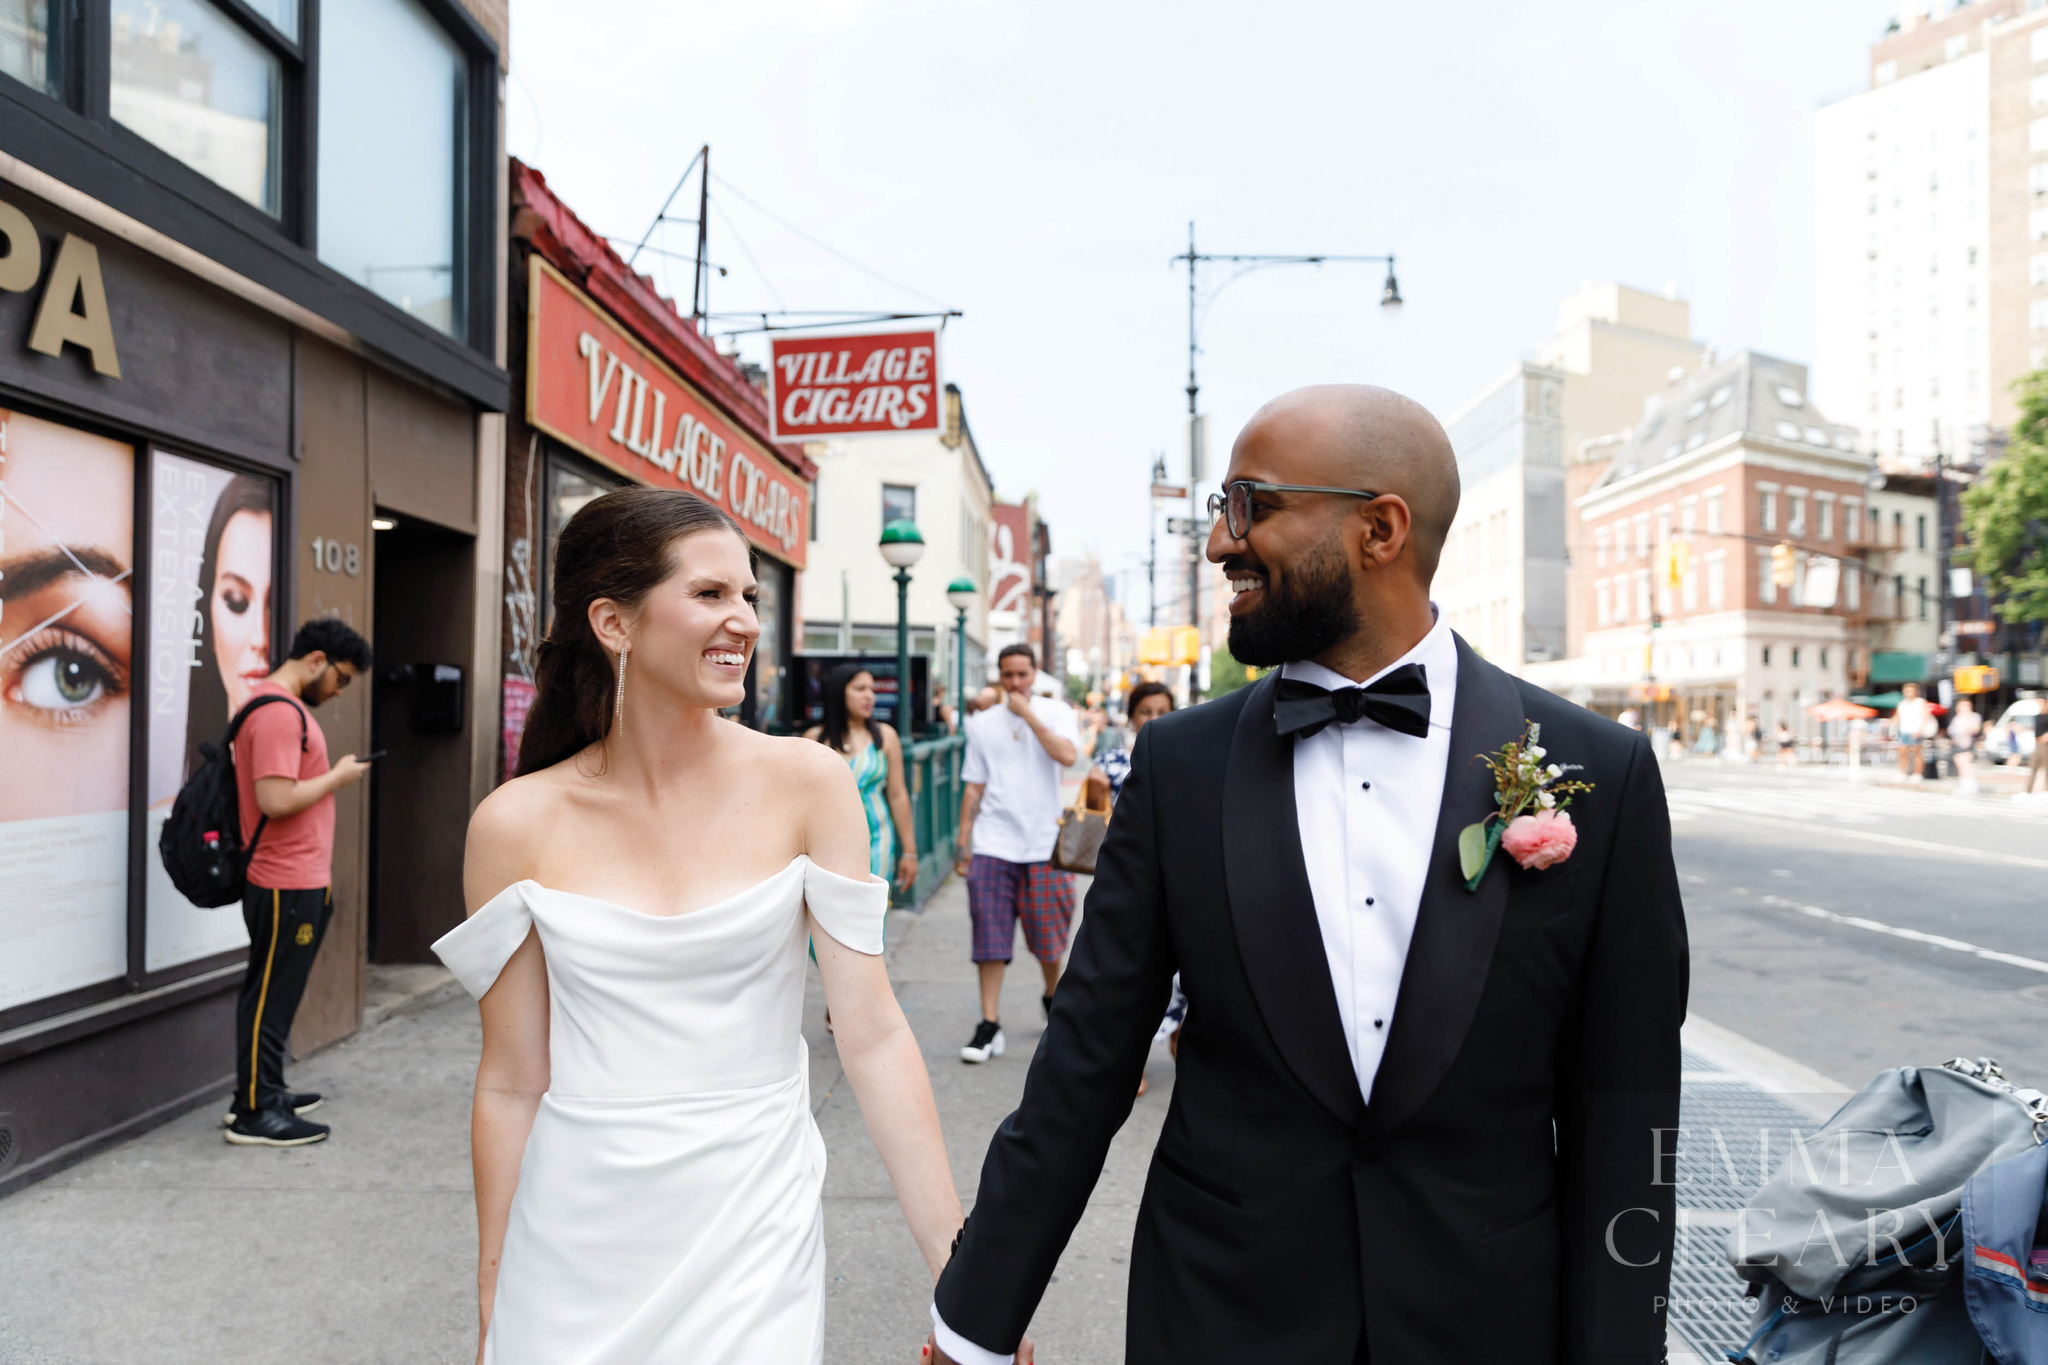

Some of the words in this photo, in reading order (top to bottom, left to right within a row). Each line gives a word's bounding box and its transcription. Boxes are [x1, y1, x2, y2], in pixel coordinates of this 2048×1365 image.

[777, 346, 932, 386] VILLAGE
[783, 384, 932, 428] CIGARS
[579, 331, 727, 500] VILLAGE
[729, 452, 800, 551] CIGARS
[156, 463, 180, 715] EXTENSION
[184, 471, 207, 667] EYELASH
[311, 536, 360, 576] 108
